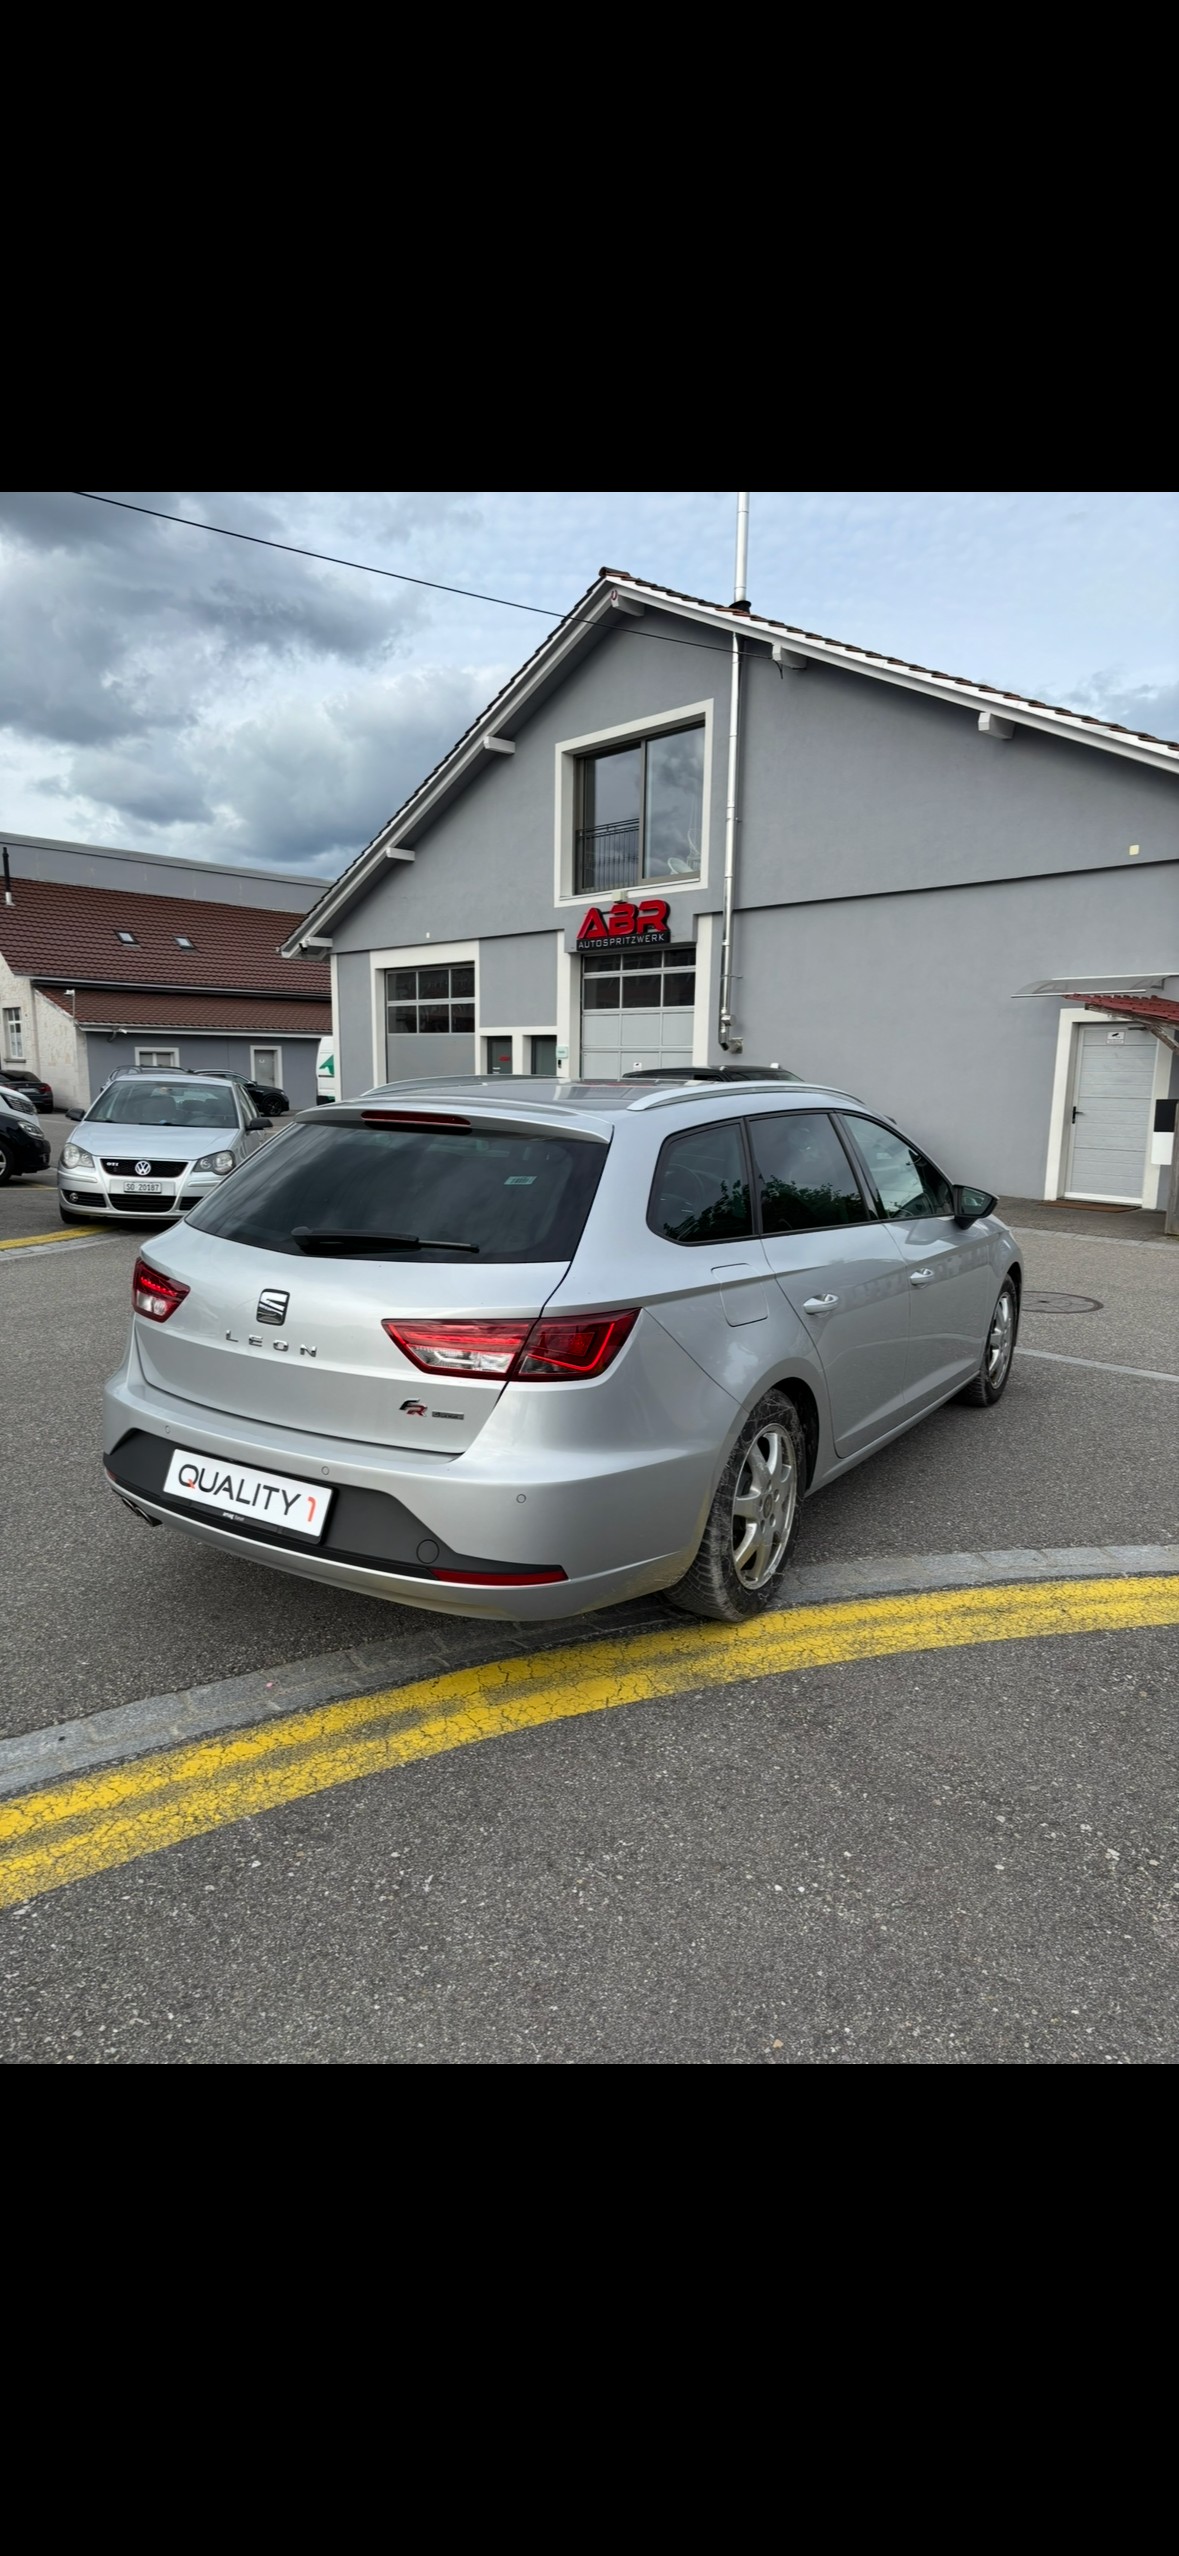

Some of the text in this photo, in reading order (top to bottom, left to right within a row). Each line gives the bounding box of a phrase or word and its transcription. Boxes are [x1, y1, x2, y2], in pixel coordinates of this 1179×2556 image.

[577, 899, 670, 939] ABR
[578, 934, 665, 949] AUTOSPRITZWERK
[225, 1329, 317, 1358] LEON
[399, 1398, 428, 1417] FR
[178, 1463, 317, 1522] QUALITY 1
